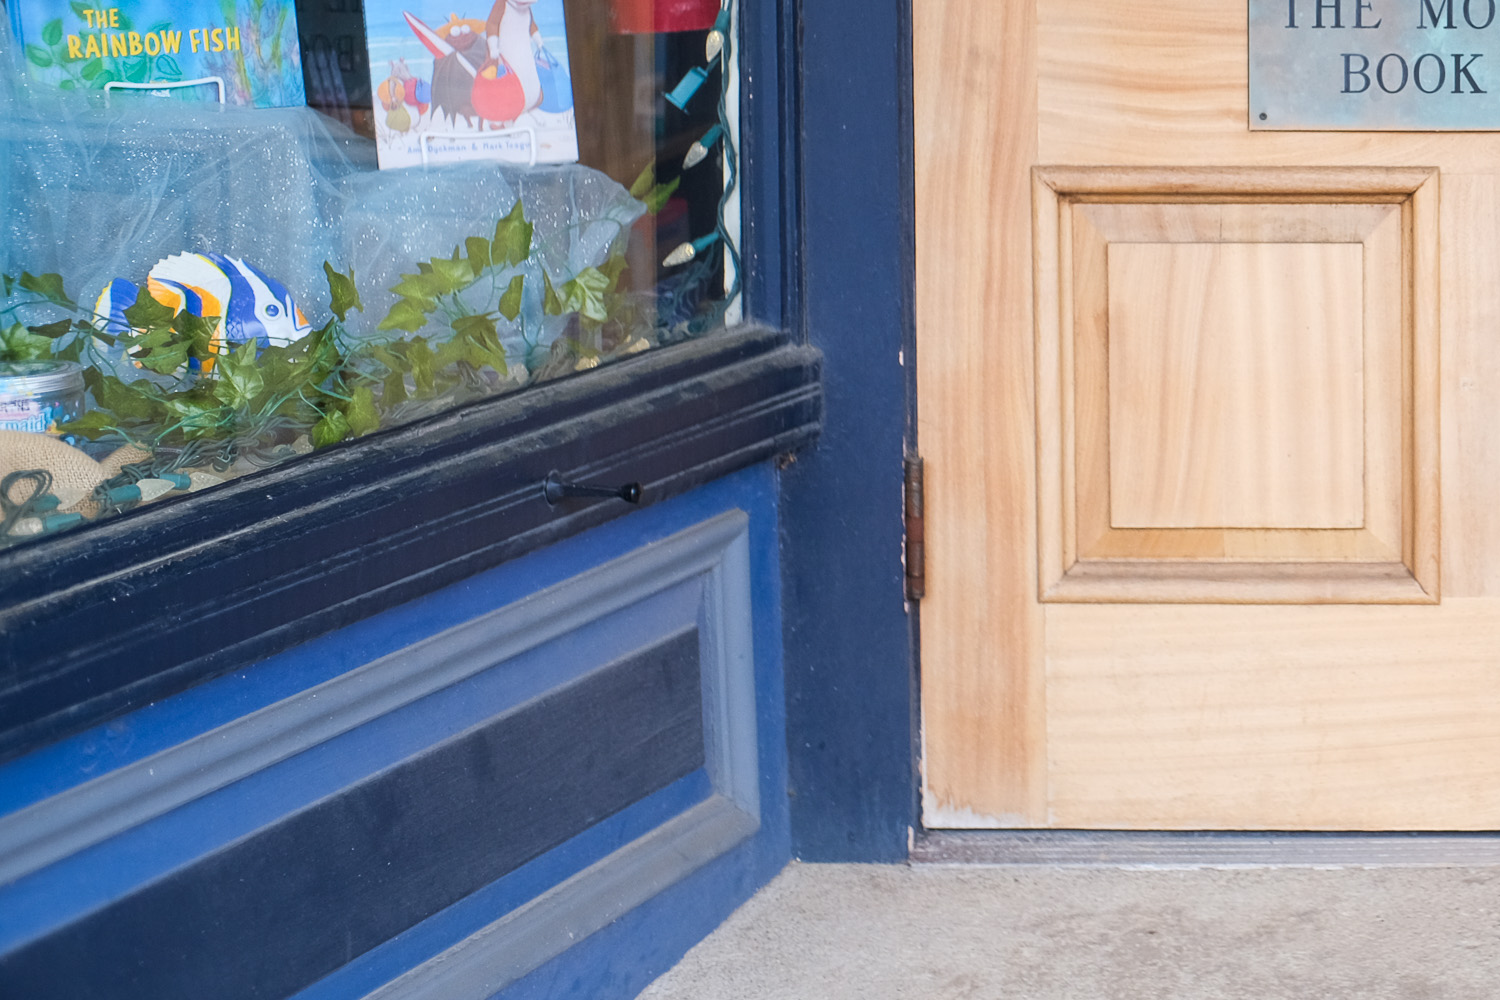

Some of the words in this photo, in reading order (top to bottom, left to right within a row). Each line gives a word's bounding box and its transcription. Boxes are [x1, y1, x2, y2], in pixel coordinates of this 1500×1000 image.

[83, 8, 119, 29] THE
[67, 29, 182, 59] RAINBOW
[190, 26, 241, 54] FISH
[1340, 53, 1487, 94] BOOK
[408, 145, 422, 154] Am
[427, 145, 467, 155] Dyckman
[506, 141, 531, 151] Teagu
